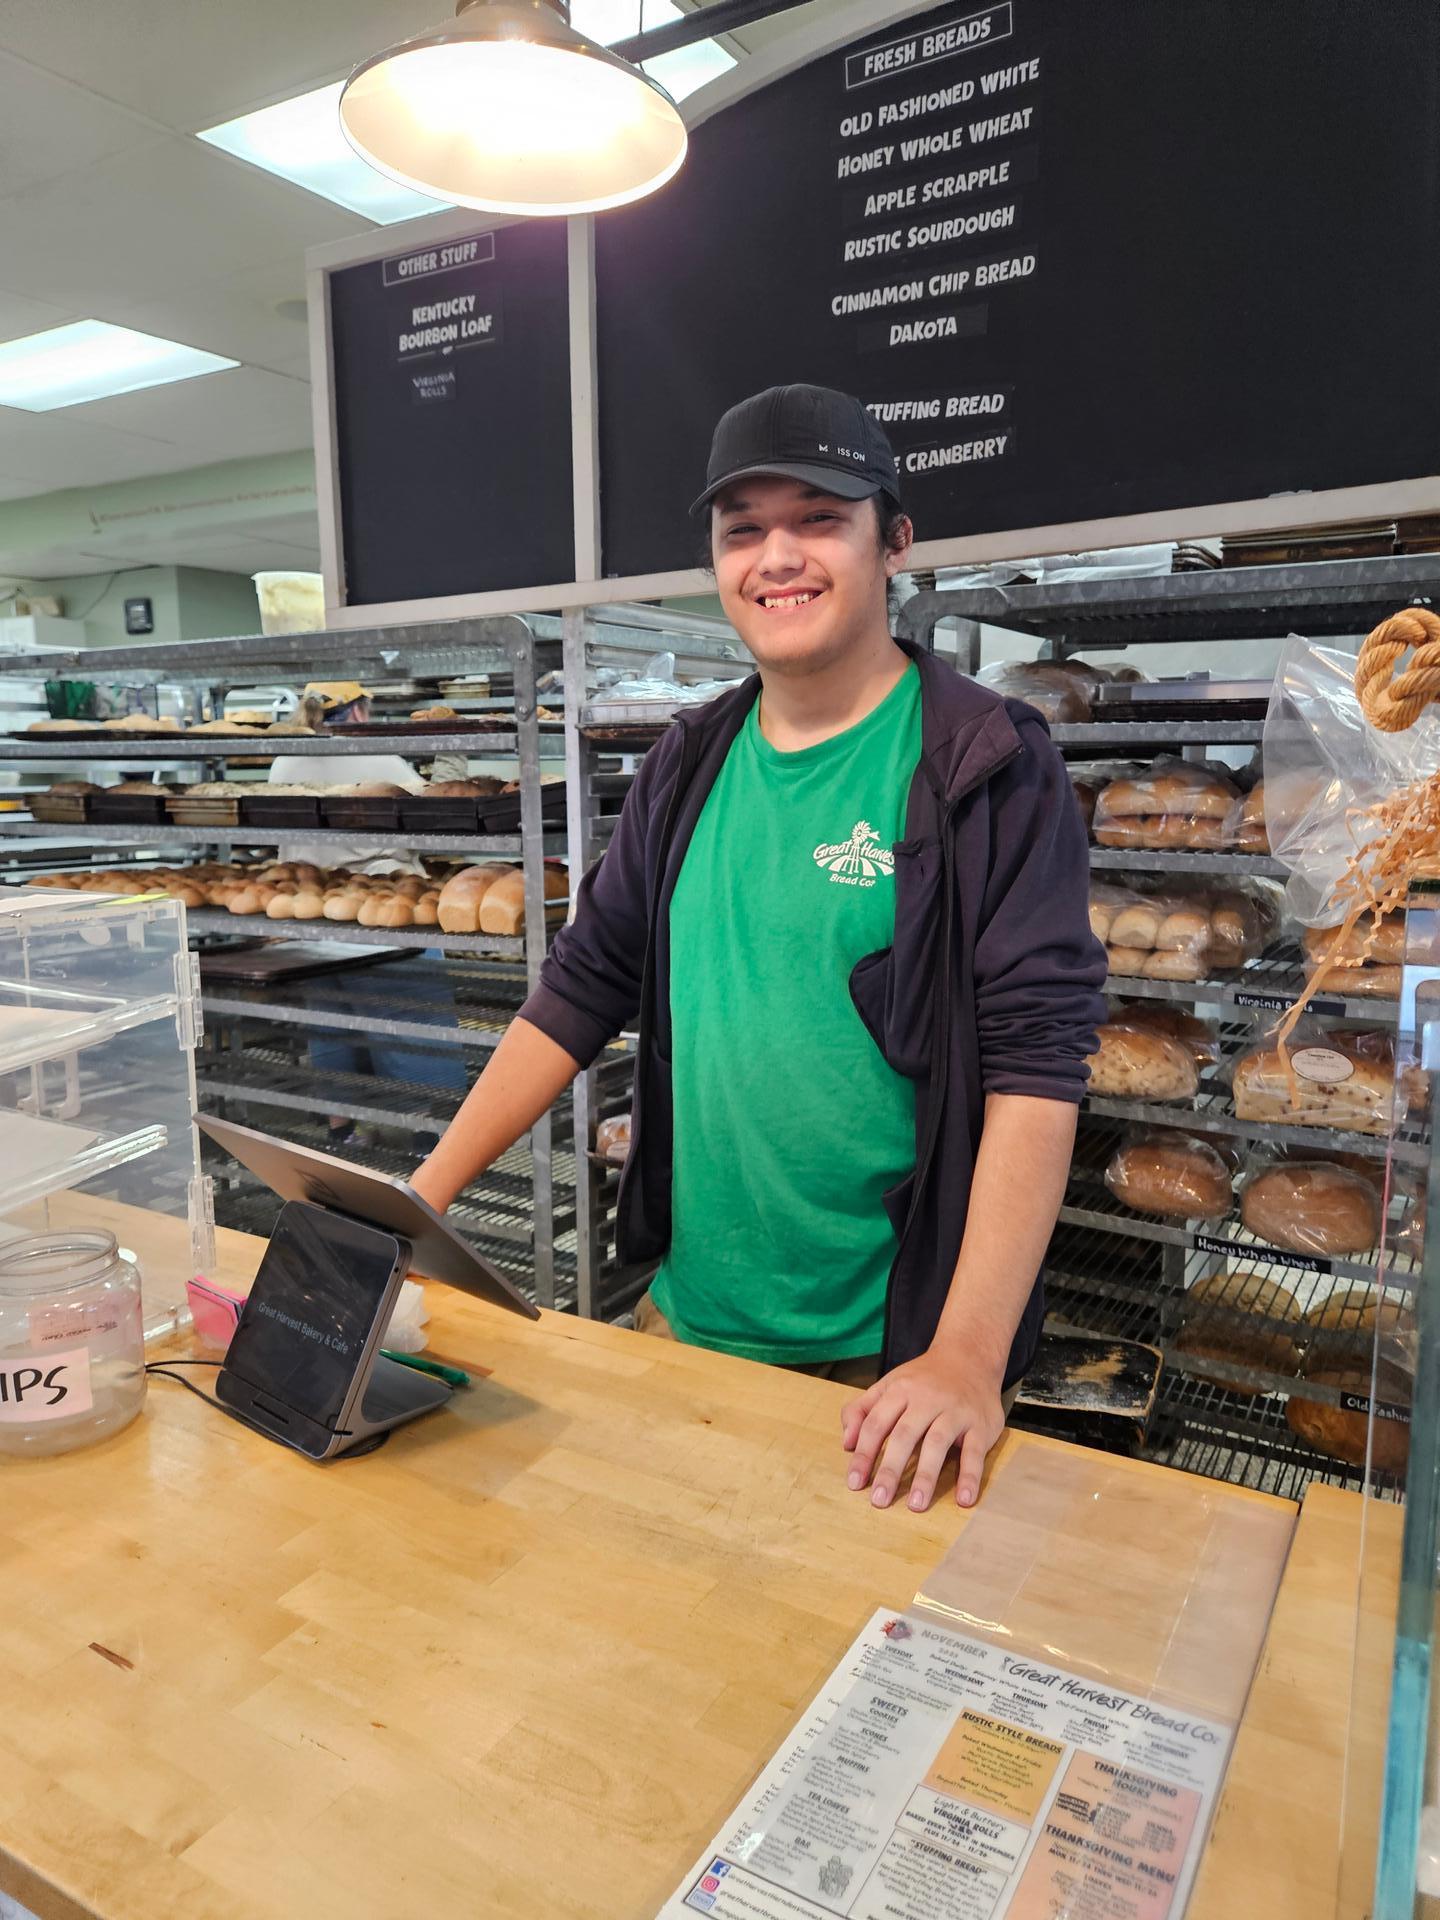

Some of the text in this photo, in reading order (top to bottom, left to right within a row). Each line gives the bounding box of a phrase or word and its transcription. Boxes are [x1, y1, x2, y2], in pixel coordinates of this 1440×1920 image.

[864, 16, 992, 77] FRESH BREADS
[839, 57, 1040, 137] OLD FASHIONED WHITE
[837, 107, 1033, 179] HONEY WHOLE WHEAT
[864, 161, 1010, 217] APPLE SCRAPPLE
[844, 205, 1015, 261] RUSTIC SOURDOUGH
[398, 241, 478, 276] OTHER STUFF
[831, 255, 1036, 316] CINNAMON CHIP BREAD
[412, 295, 476, 326] KENTUCKY
[399, 314, 492, 352] BOURBON LOAF
[889, 316, 957, 346] DAKOTA
[945, 393, 1005, 417] BREAD
[905, 436, 1008, 473] CRANBERRY
[813, 838, 895, 866] Great Harves
[829, 873, 858, 886] Bread
[1238, 996, 1281, 1010] Virginia
[1198, 1237, 1318, 1271] Honey Whole Wheat
[258, 1302, 276, 1320] Great
[277, 1309, 302, 1331] Harvest
[301, 1323, 324, 1346] Bakery
[324, 1334, 331, 1345] &
[0, 1366, 68, 1405] IPS
[1346, 1396, 1369, 1411] Old
[920, 1628, 989, 1658] NOVEMBER
[869, 1696, 909, 1716] SWEETS
[1008, 1659, 1062, 1689] Great
[1058, 1676, 1134, 1715] Harvest
[1129, 1701, 1190, 1735] Bread
[1011, 1692, 1048, 1709] THURSDAY
[867, 1707, 900, 1723] COOKIES
[859, 1726, 889, 1742] SCONES
[961, 1711, 994, 1728] RUSTIC
[994, 1723, 1023, 1739] STYLE
[1024, 1734, 1063, 1754] BREADS
[835, 1754, 871, 1773] MUFFINS
[1092, 1759, 1179, 1799] THANKSGIVING
[806, 1790, 823, 1802] TEA
[931, 1806, 1000, 1839] VIRGINIA ROLLS
[1043, 1823, 1135, 1866] THANKSGIVING
[1136, 1860, 1176, 1883] MENU
